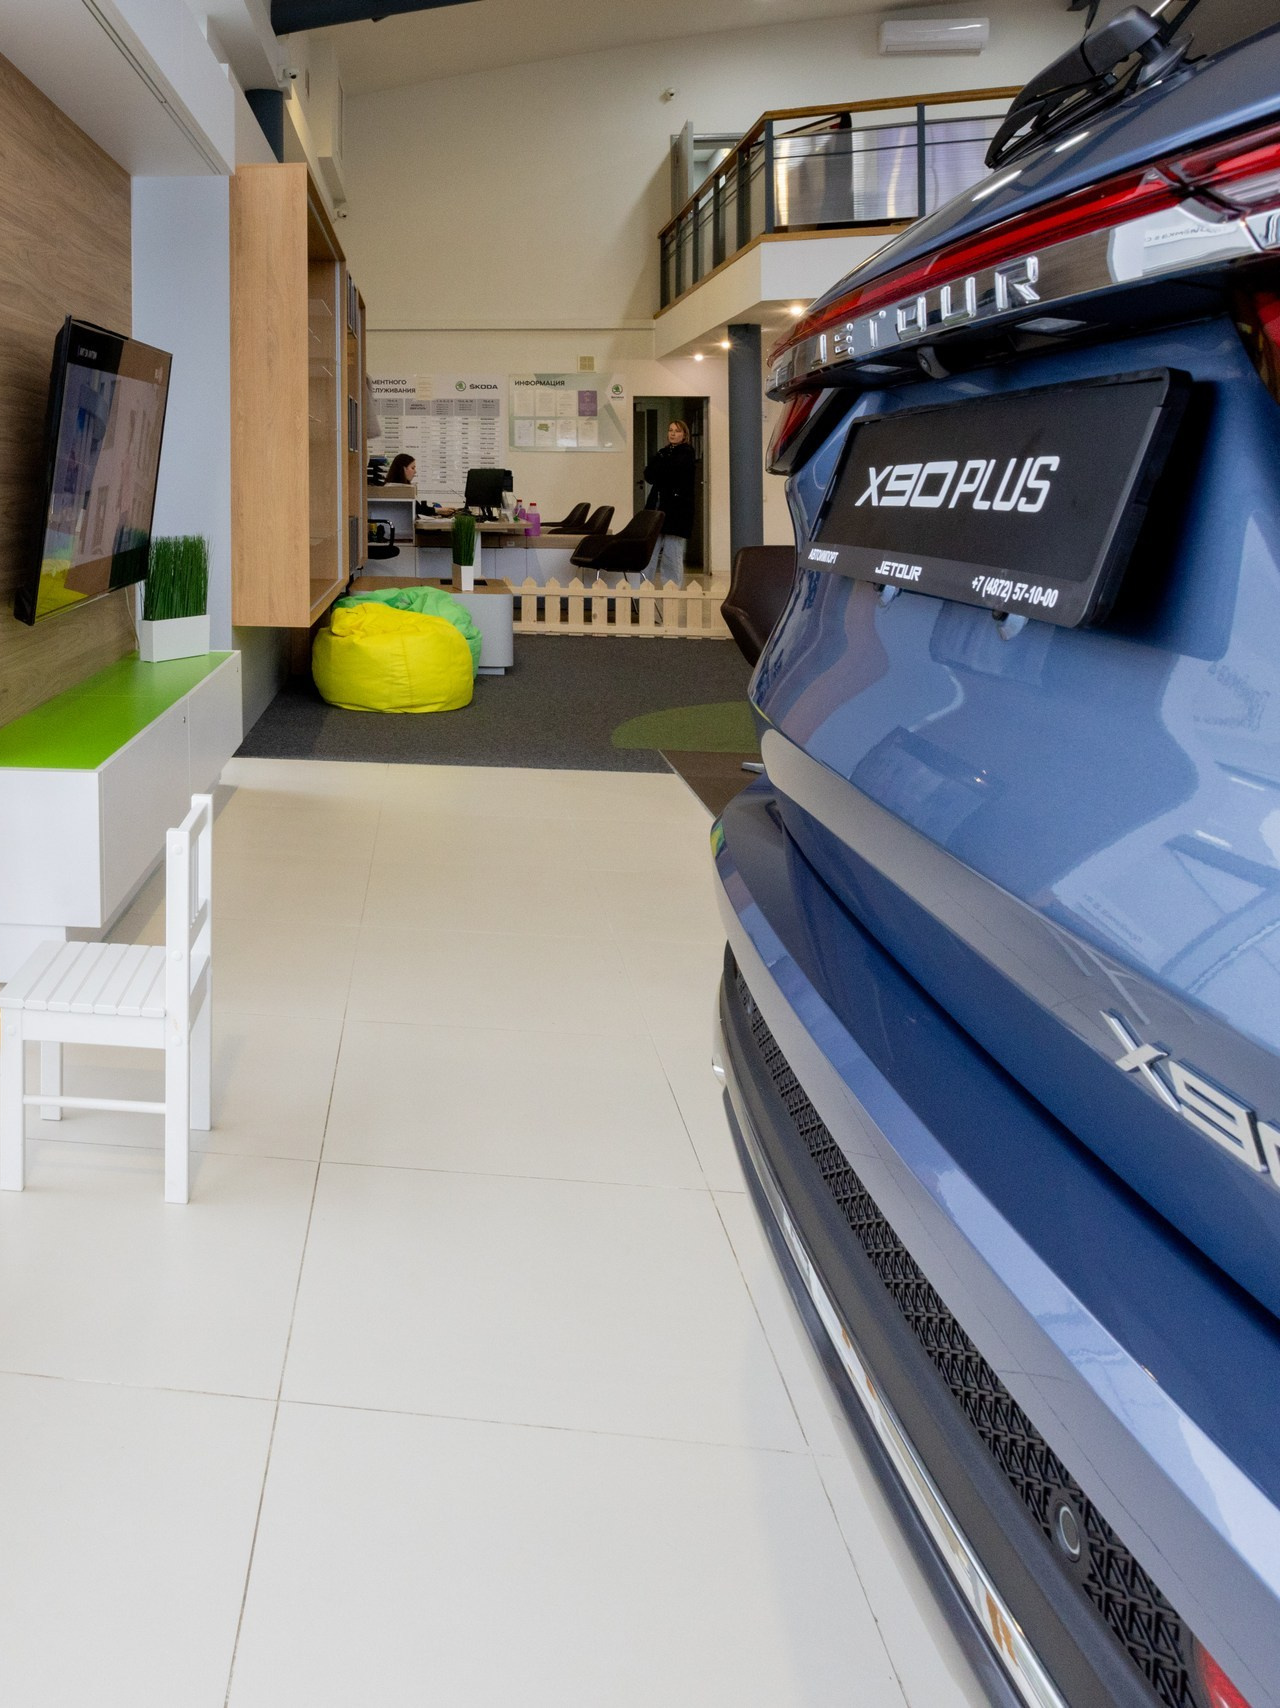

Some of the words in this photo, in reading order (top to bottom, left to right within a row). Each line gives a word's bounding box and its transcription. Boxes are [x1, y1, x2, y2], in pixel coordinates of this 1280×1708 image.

[468, 383, 499, 391] ŠKODA
[514, 379, 566, 388] ИНФОРМАЦИЯ
[854, 459, 960, 509] X90
[947, 455, 1061, 514] PLUS
[874, 560, 923, 582] JETOUR
[971, 575, 985, 593] +7
[981, 576, 1014, 603] (4872)
[1011, 582, 1060, 609] 57-10-00
[1098, 1009, 1280, 1194] X9
